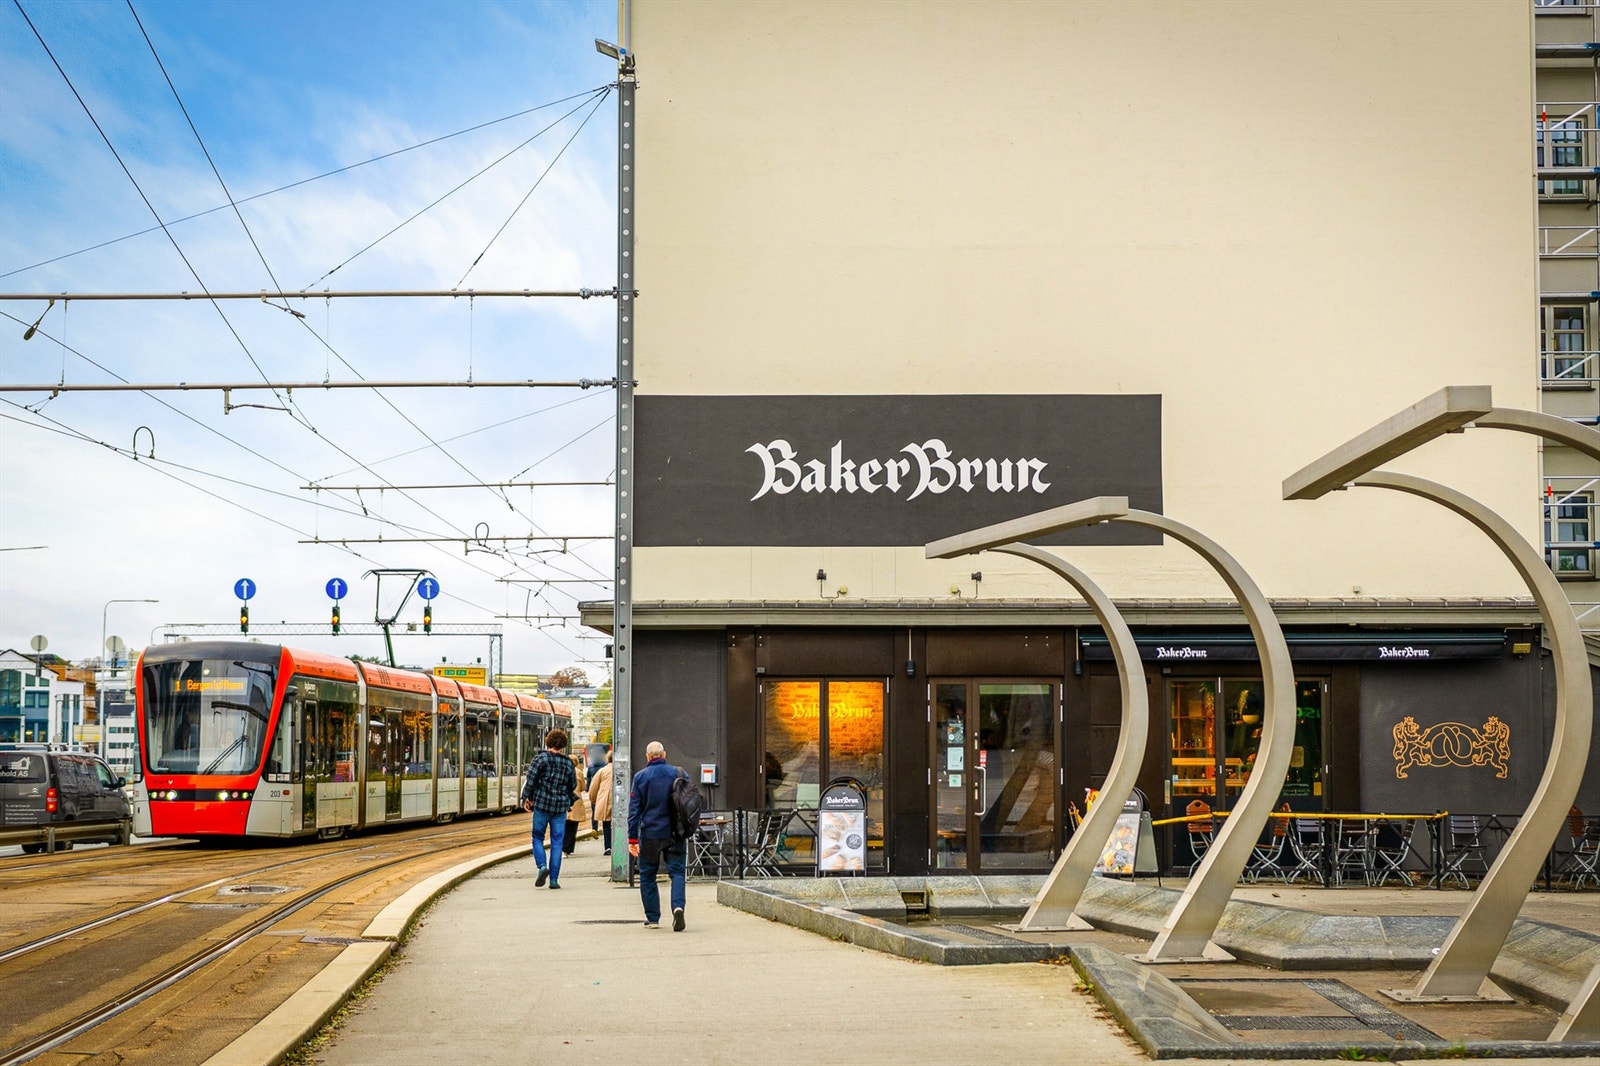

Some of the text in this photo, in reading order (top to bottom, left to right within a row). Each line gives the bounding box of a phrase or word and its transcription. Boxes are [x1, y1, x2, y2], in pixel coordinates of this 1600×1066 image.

[745, 438, 1051, 501] BakerBrun
[1156, 646, 1207, 659] BakerBrun
[1379, 646, 1429, 658] BakerBrun
[175, 681, 181, 692] 1
[186, 679, 212, 691] Bergen
[791, 702, 874, 719] BakrBrun
[270, 790, 281, 798] 203
